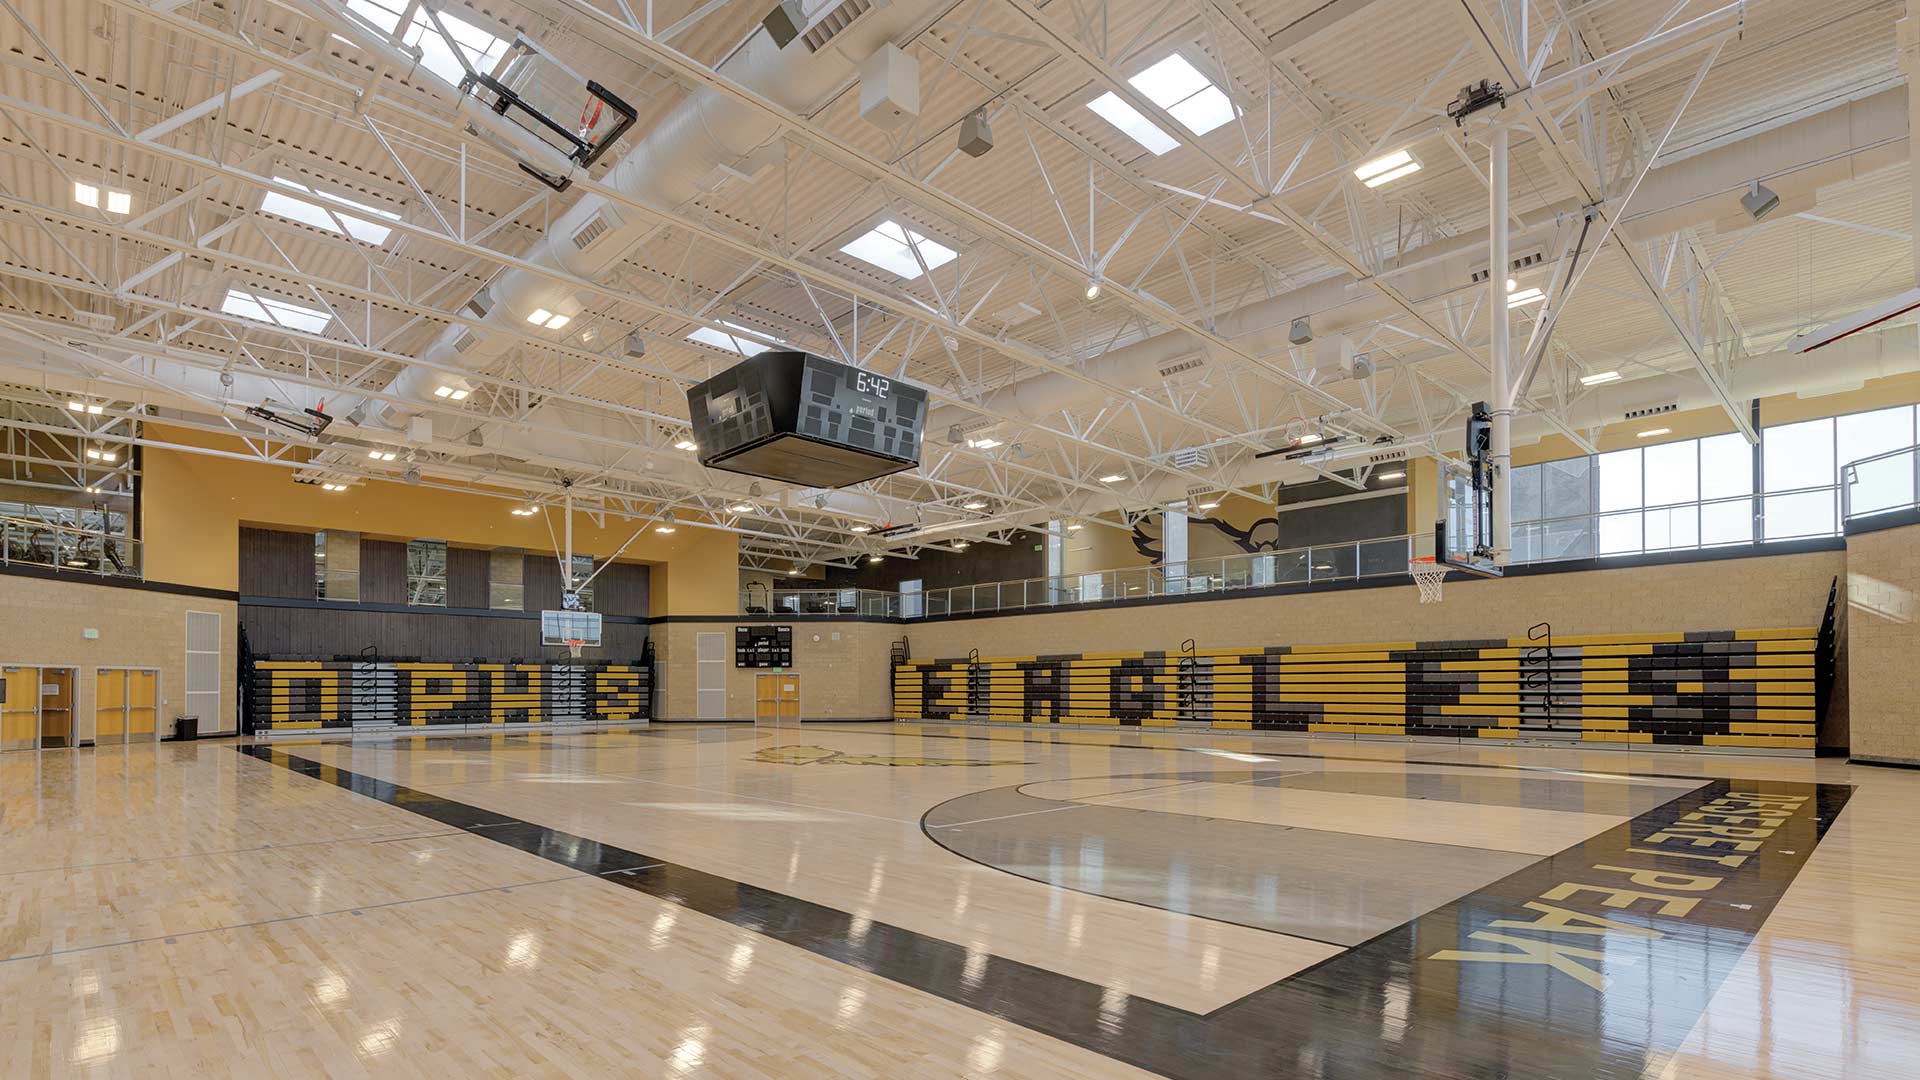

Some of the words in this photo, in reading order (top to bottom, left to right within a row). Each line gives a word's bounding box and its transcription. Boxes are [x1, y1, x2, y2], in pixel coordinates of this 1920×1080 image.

[857, 372, 889, 399] 6:42
[1625, 791, 1810, 868] DESERET
[1428, 864, 1724, 992] PEAK
